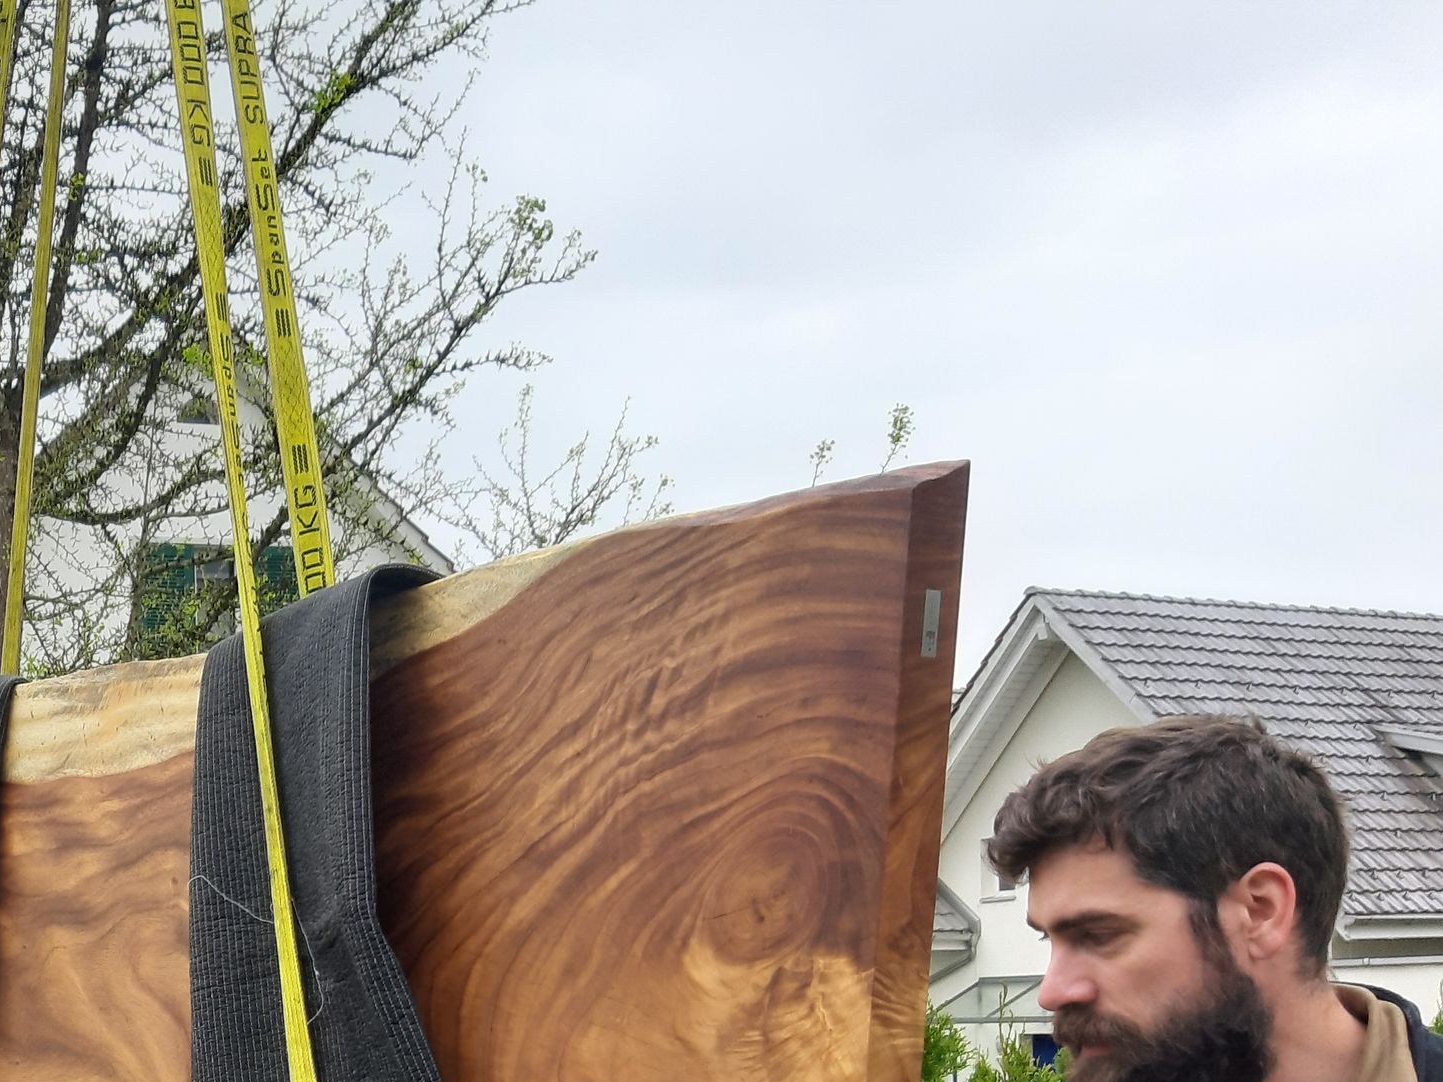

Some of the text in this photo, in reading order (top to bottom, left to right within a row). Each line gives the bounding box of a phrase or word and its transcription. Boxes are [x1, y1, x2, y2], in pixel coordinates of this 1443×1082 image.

[187, 99, 211, 147] KG
[232, 12, 287, 297] SpanSet SUPRA
[293, 485, 320, 535] KG
